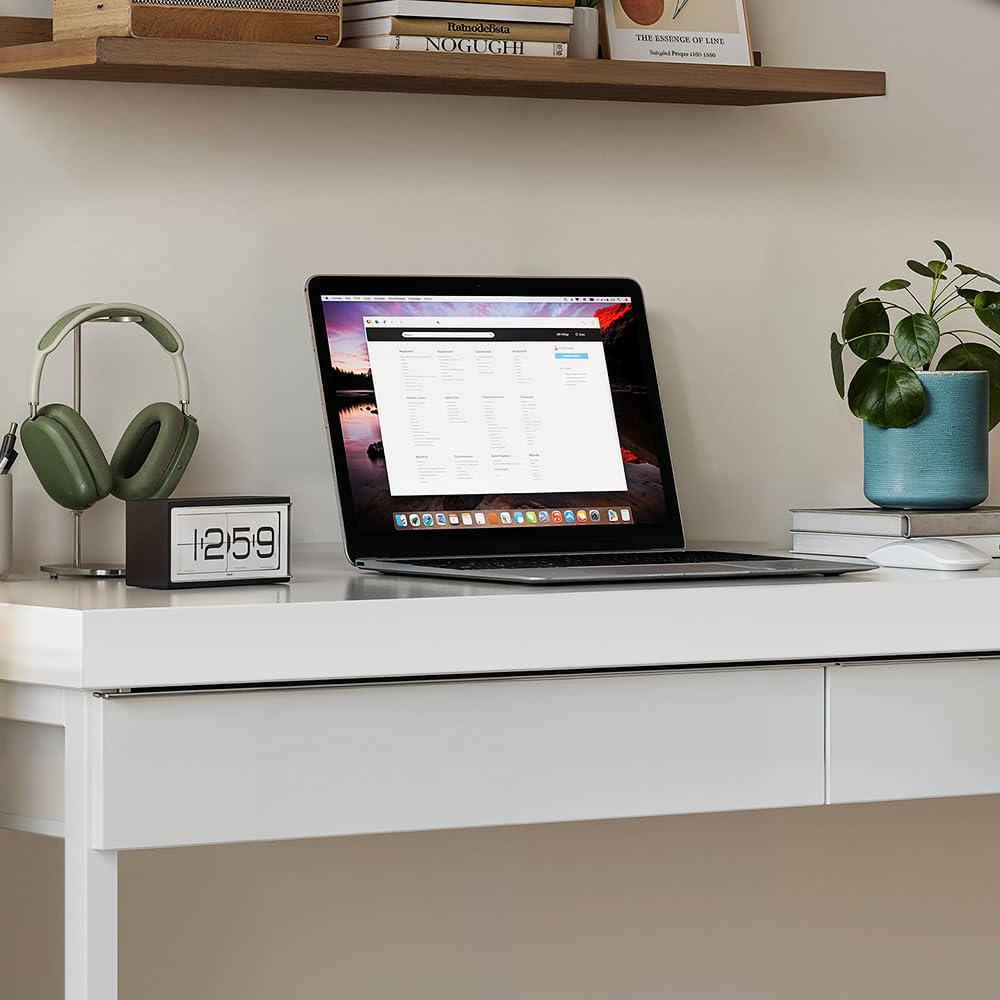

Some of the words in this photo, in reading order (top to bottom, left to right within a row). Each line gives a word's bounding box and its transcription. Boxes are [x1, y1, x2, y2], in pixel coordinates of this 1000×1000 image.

[635, 33, 654, 42] THE
[692, 36, 704, 44] OF
[705, 37, 726, 45] LINE
